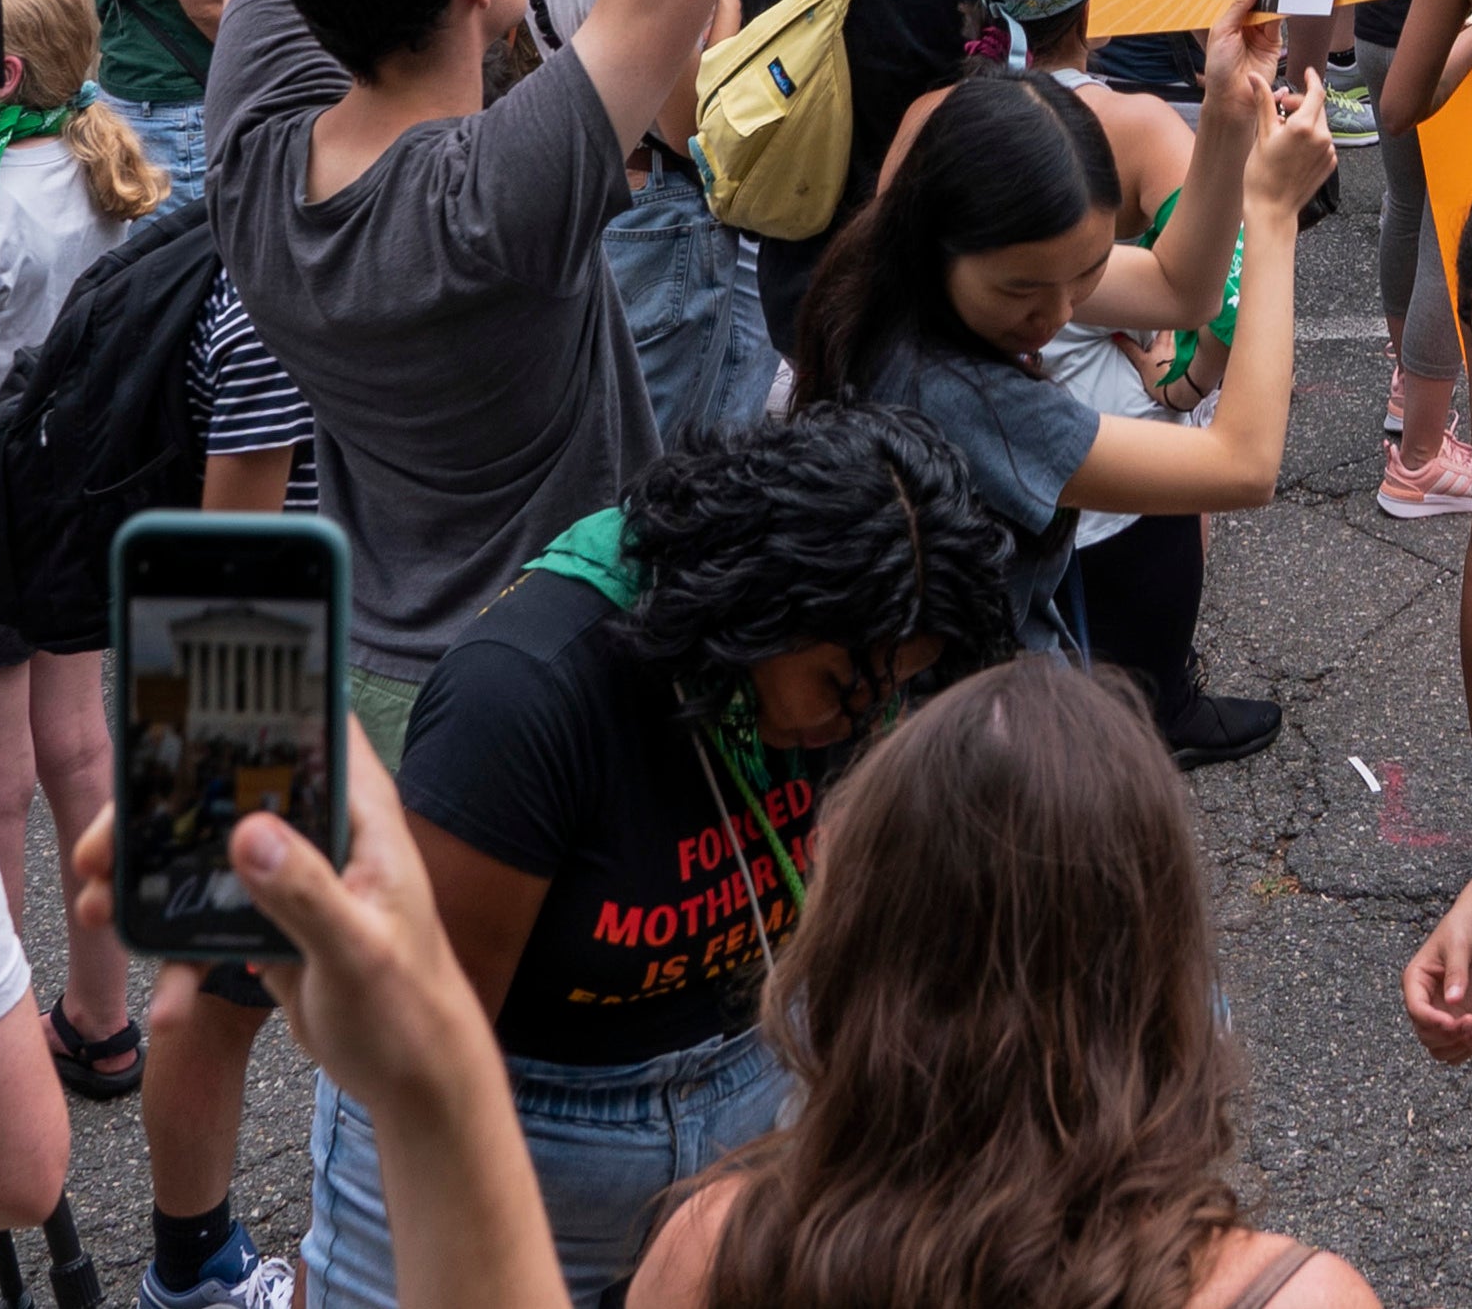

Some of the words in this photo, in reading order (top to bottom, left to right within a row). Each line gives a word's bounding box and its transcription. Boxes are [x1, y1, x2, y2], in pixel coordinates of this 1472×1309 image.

[678, 779, 813, 882] FORCED
[592, 829, 818, 949] MOTHERH
[641, 954, 689, 990] IS
